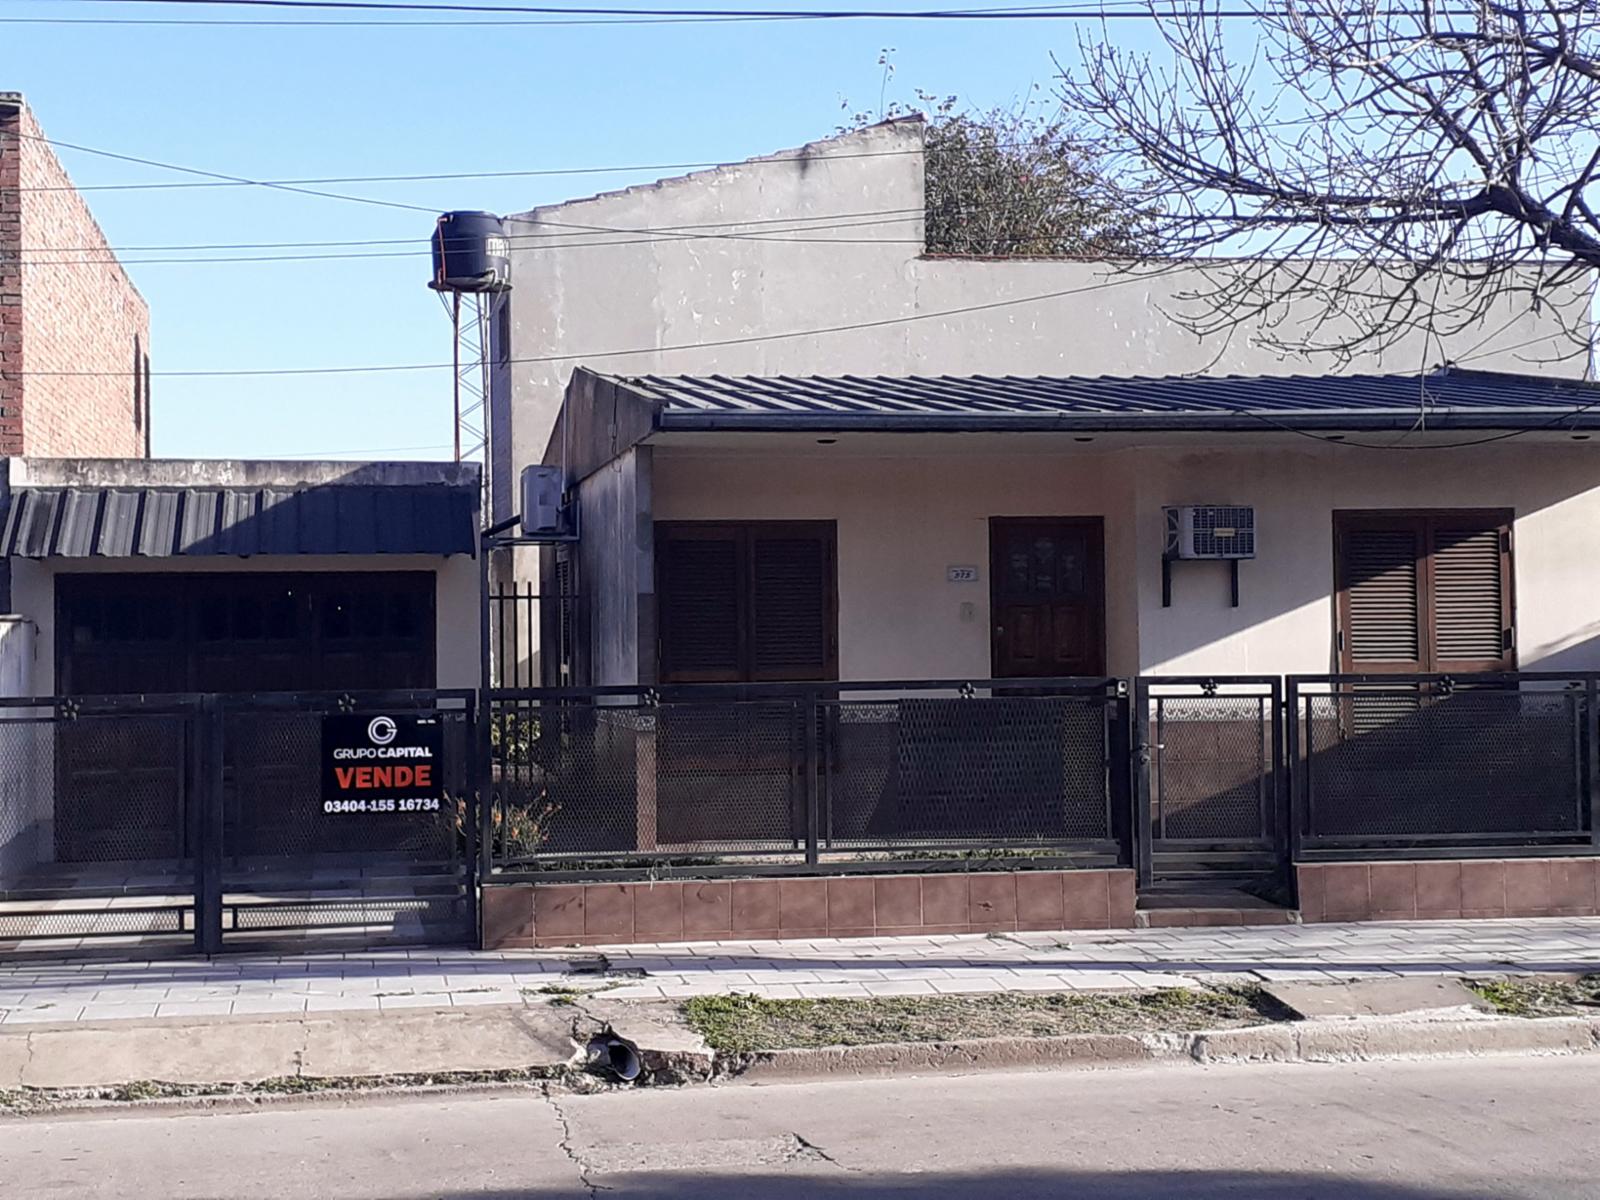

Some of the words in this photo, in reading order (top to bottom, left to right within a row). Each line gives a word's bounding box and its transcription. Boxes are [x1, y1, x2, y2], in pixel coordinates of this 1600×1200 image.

[333, 748, 376, 759] GRUPO
[378, 746, 433, 758] CAPITAL
[335, 765, 432, 789] VENDE
[324, 799, 395, 813] 03404-155
[398, 798, 440, 812] 16734
